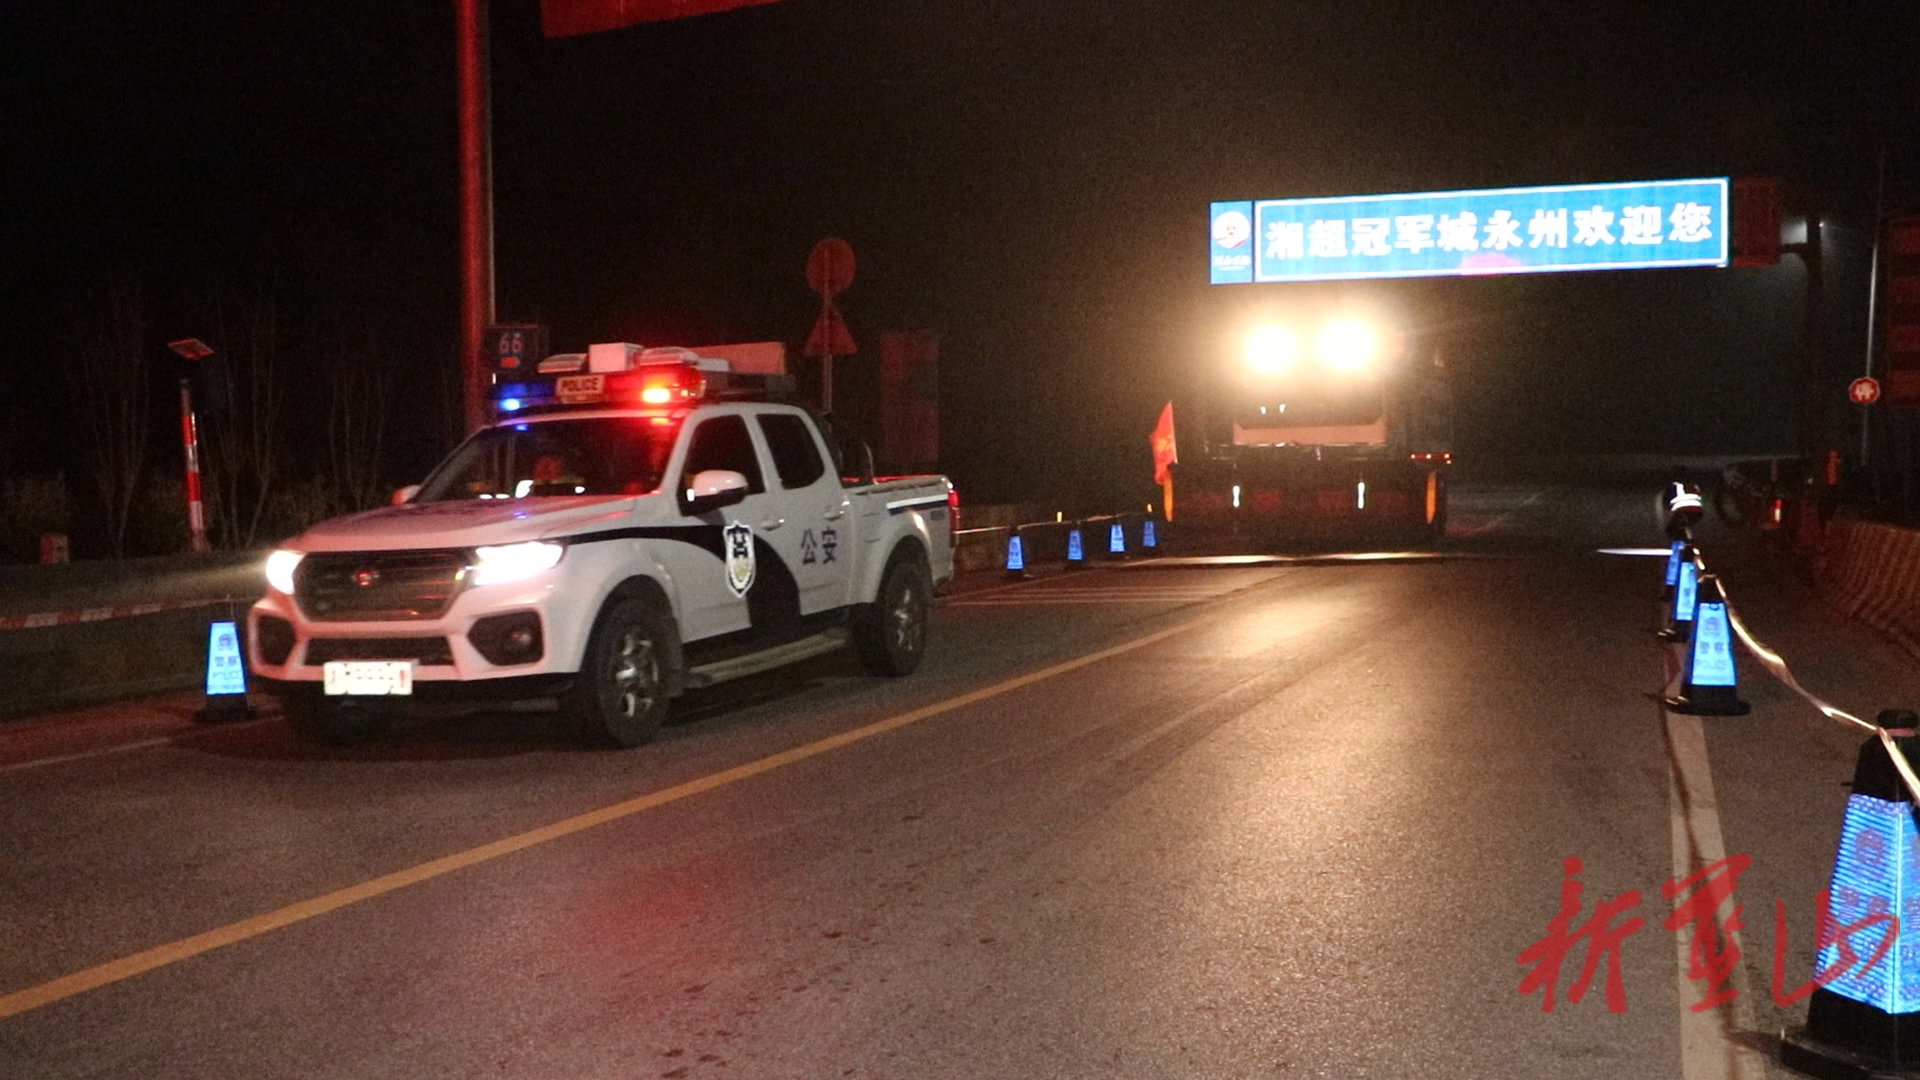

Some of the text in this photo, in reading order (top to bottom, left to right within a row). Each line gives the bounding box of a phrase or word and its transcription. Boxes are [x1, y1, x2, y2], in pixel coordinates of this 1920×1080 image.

[1265, 202, 1714, 260] 湘超冠军城永州欢迎您
[562, 377, 599, 392] POLICE
[800, 525, 837, 565] 公安
